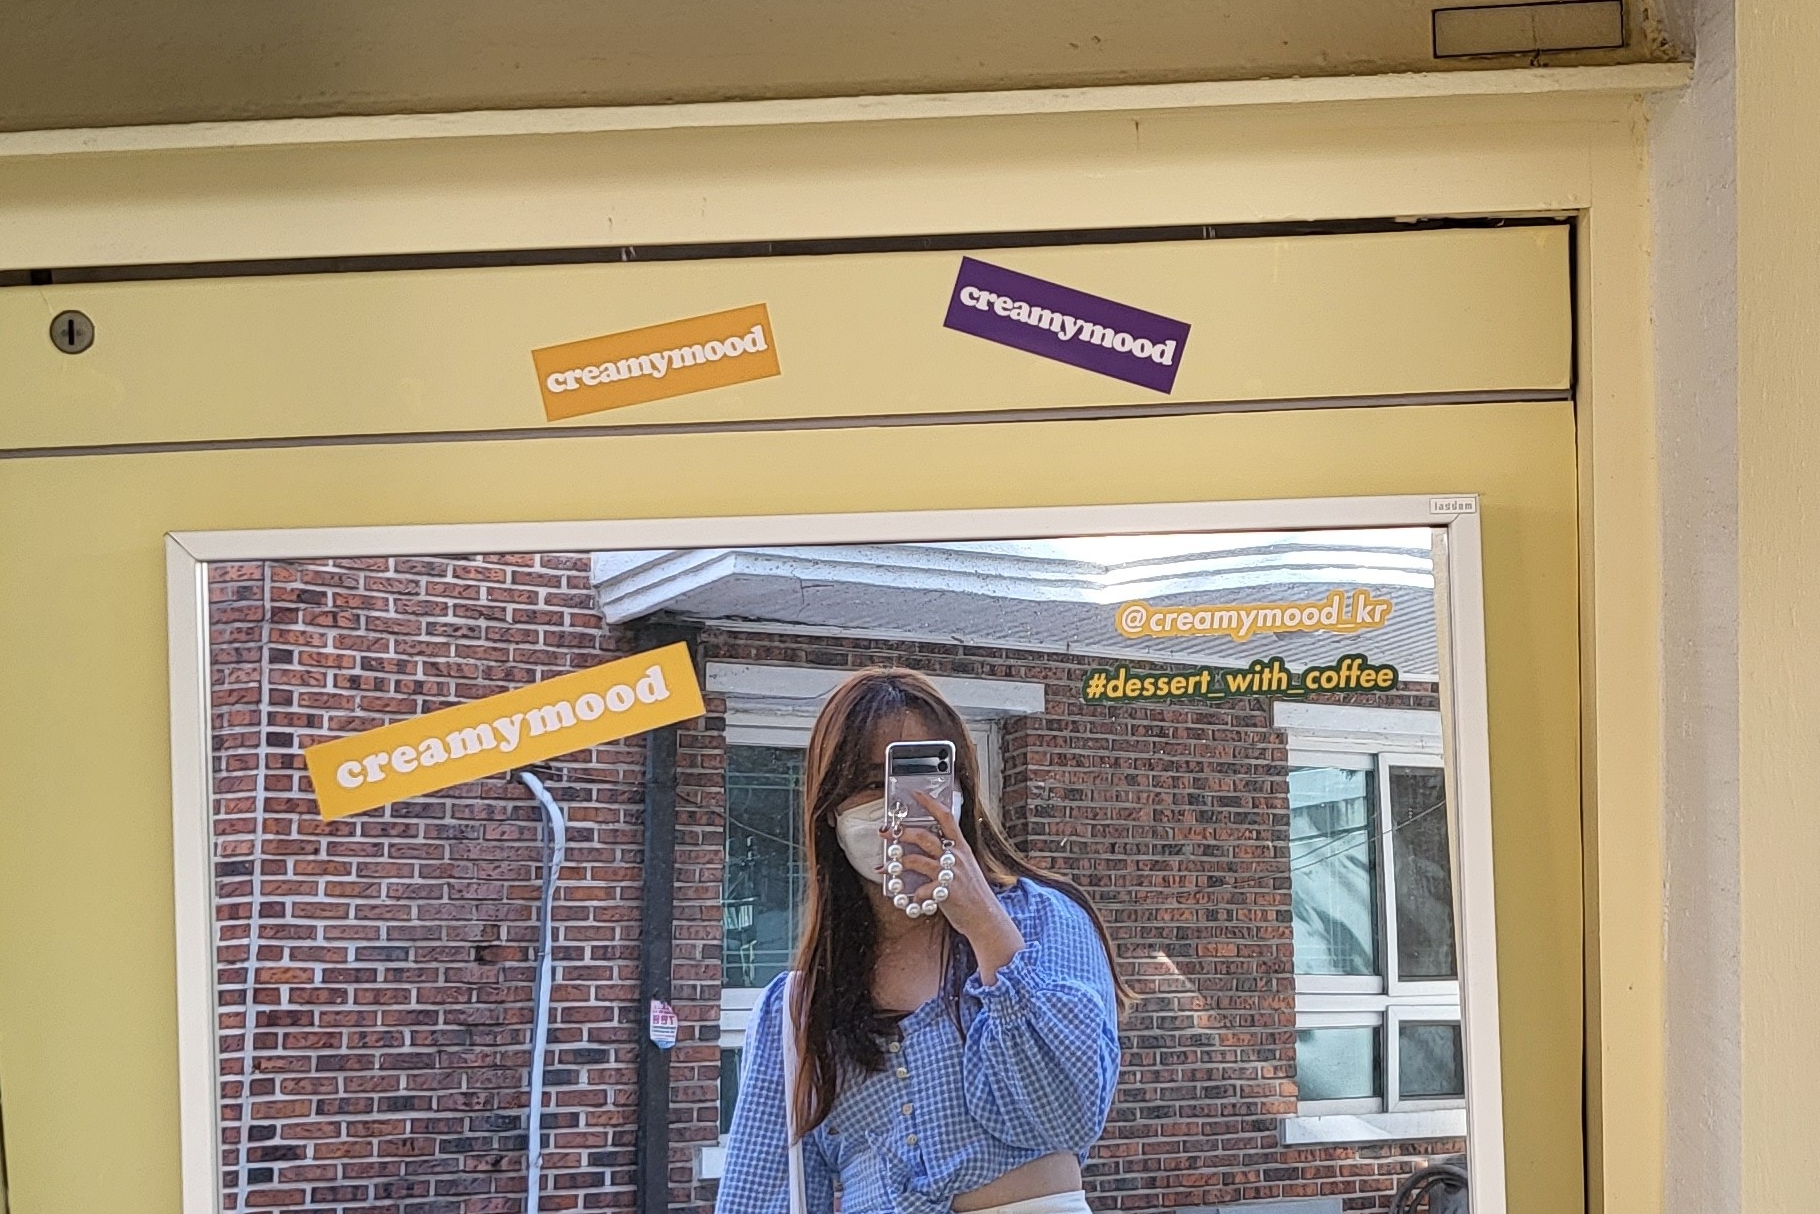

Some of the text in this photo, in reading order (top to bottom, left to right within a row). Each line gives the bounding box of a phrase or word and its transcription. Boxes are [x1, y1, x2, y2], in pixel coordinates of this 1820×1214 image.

[546, 325, 768, 393] creamymood
[959, 286, 1177, 366] creamymood
[1120, 595, 1388, 637] @creamymood_kr
[1086, 658, 1395, 699] #dessert_with_coffee
[336, 665, 670, 789] creamymood
